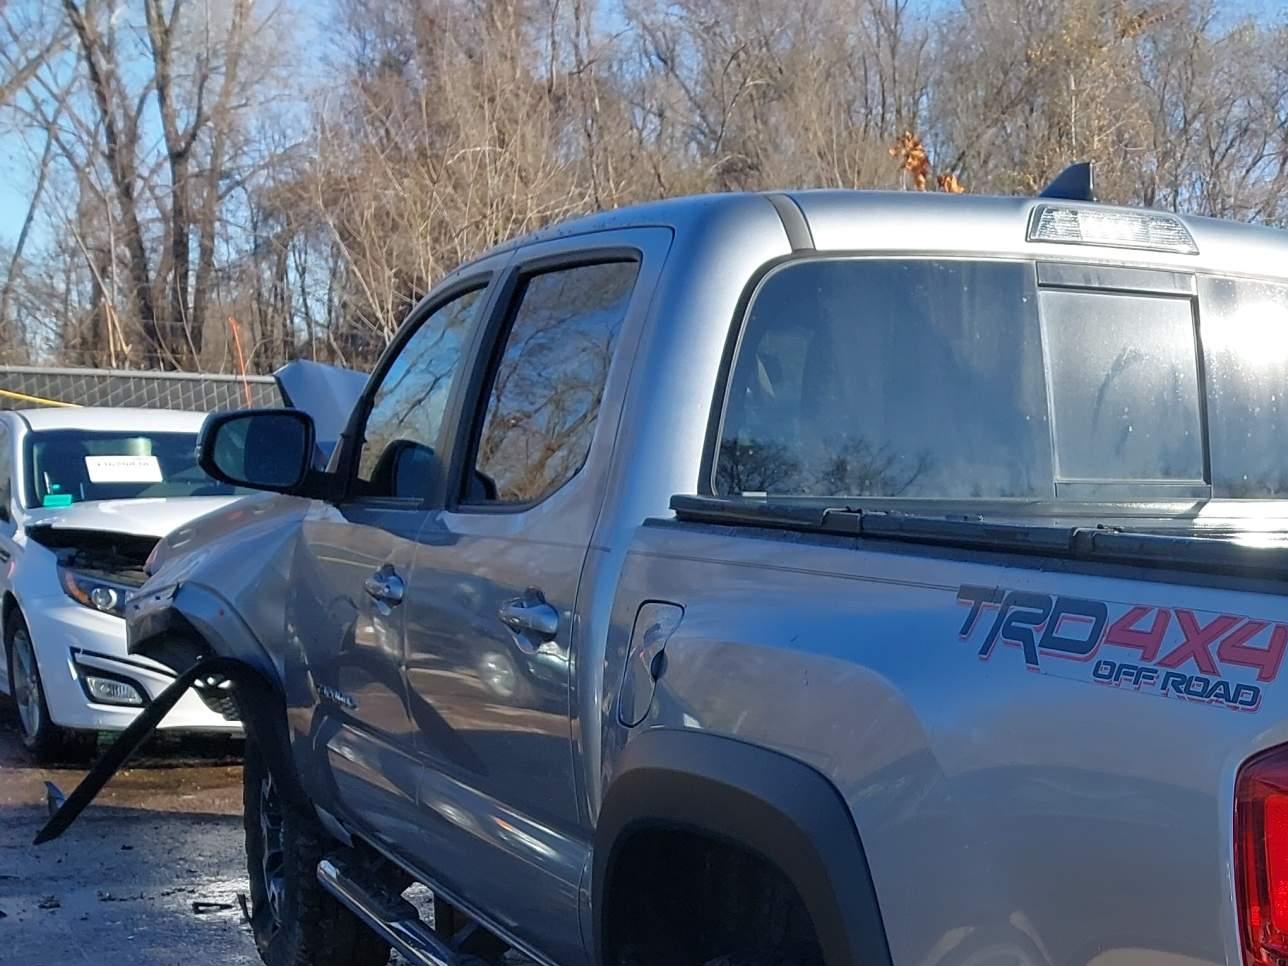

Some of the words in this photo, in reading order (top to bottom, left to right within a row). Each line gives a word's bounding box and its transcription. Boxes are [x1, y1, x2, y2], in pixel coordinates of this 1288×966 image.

[956, 584, 1109, 673] TRD
[1092, 659, 1158, 691] OFF
[1160, 671, 1263, 713] ROAD
